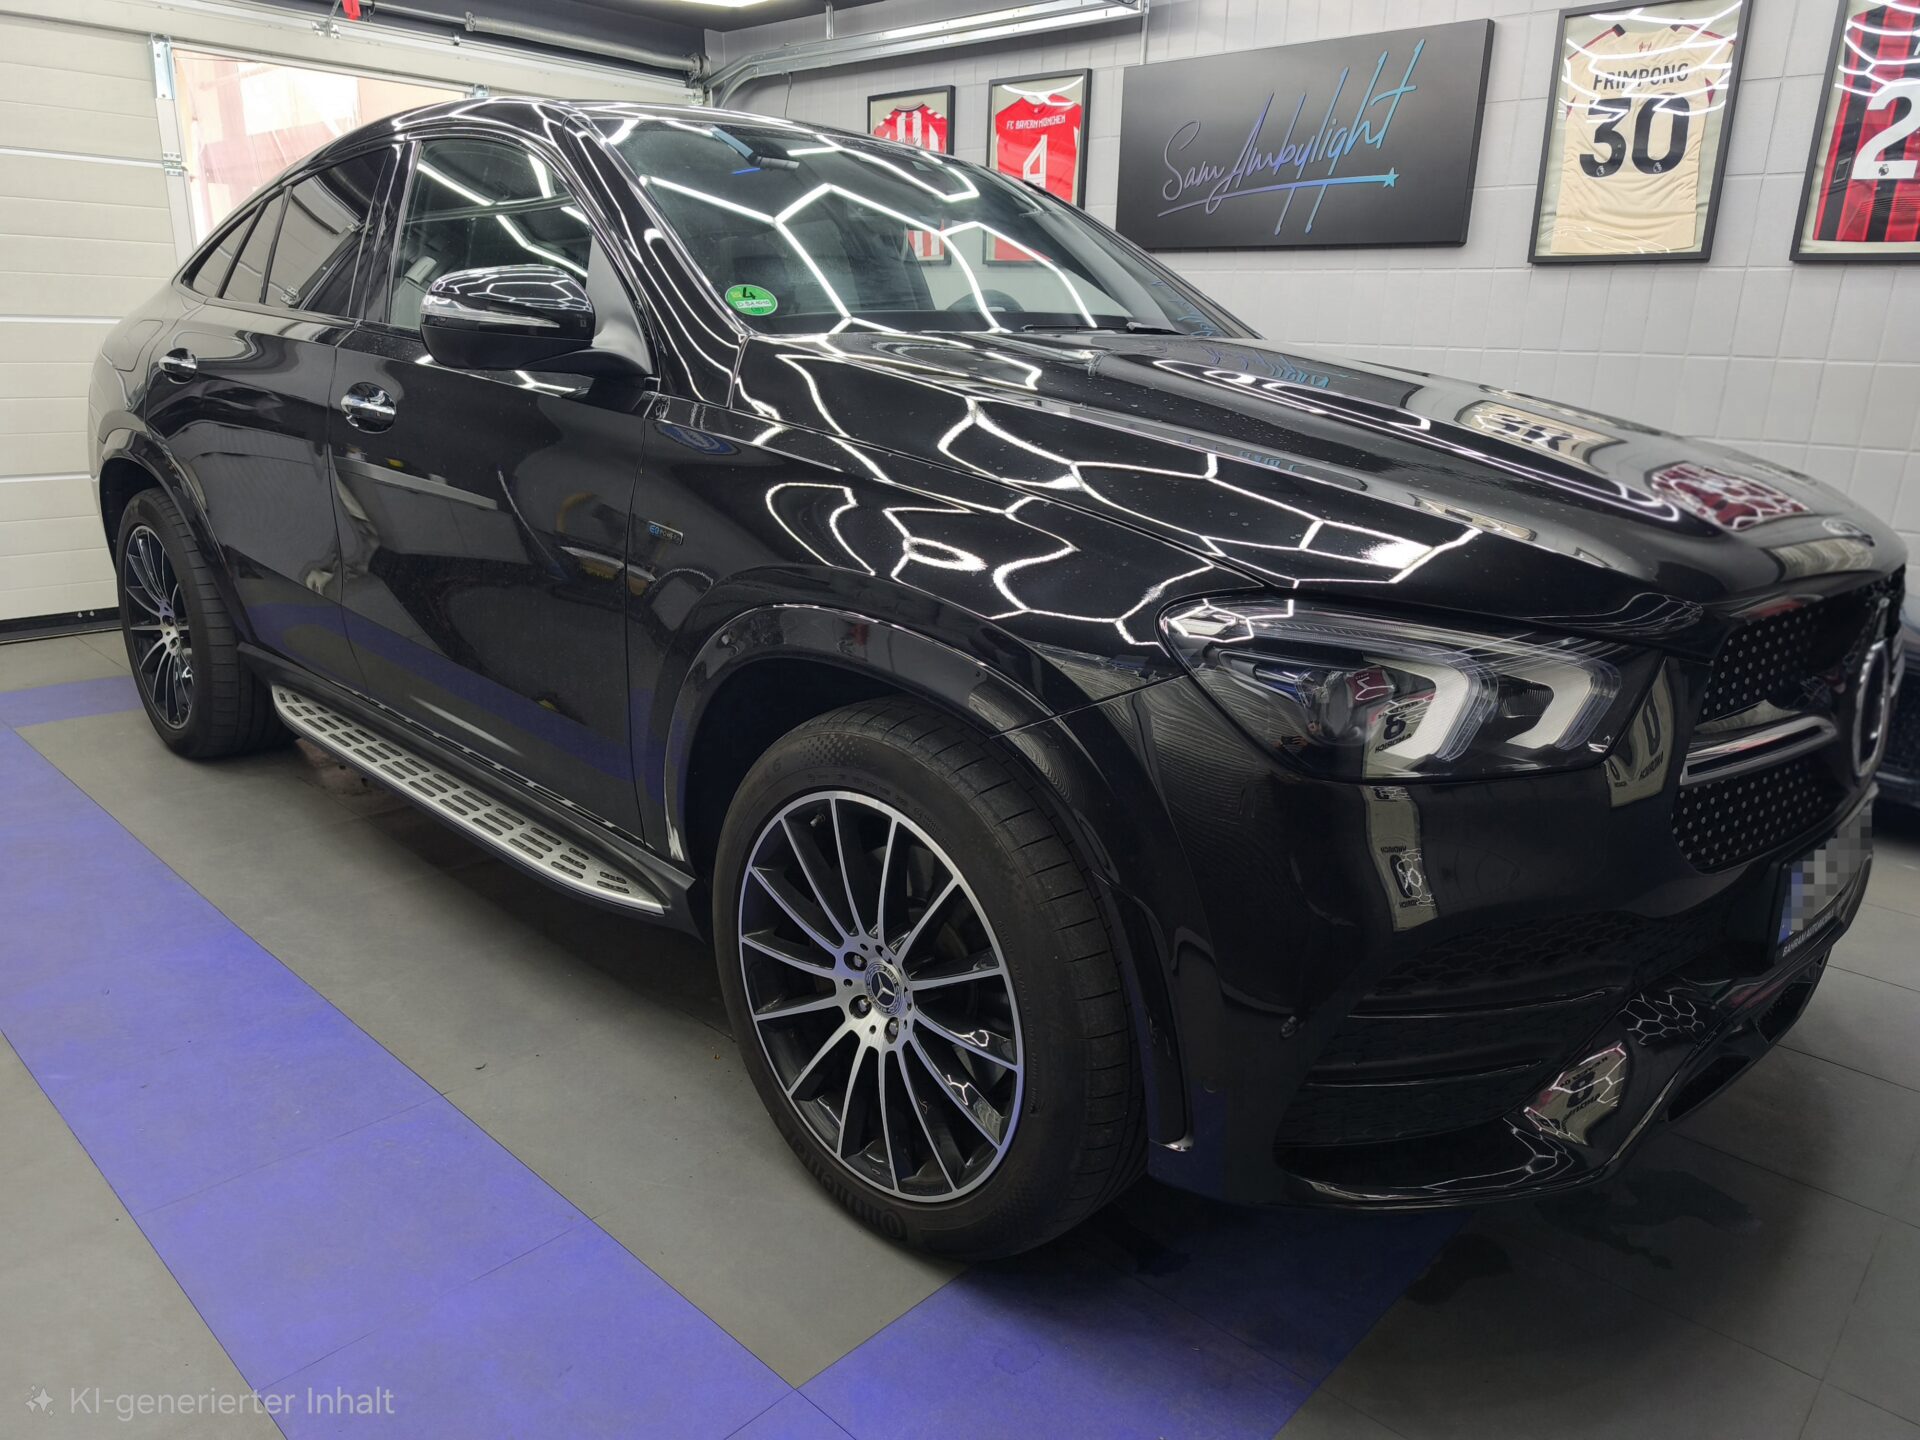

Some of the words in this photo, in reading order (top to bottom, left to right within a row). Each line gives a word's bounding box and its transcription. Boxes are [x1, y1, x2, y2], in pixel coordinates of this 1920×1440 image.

[1593, 63, 1689, 91] FRIMPONG
[1006, 120, 1014, 130] FC
[1579, 92, 1690, 178] 30
[1023, 134, 1048, 189] 4
[742, 287, 756, 299] 4
